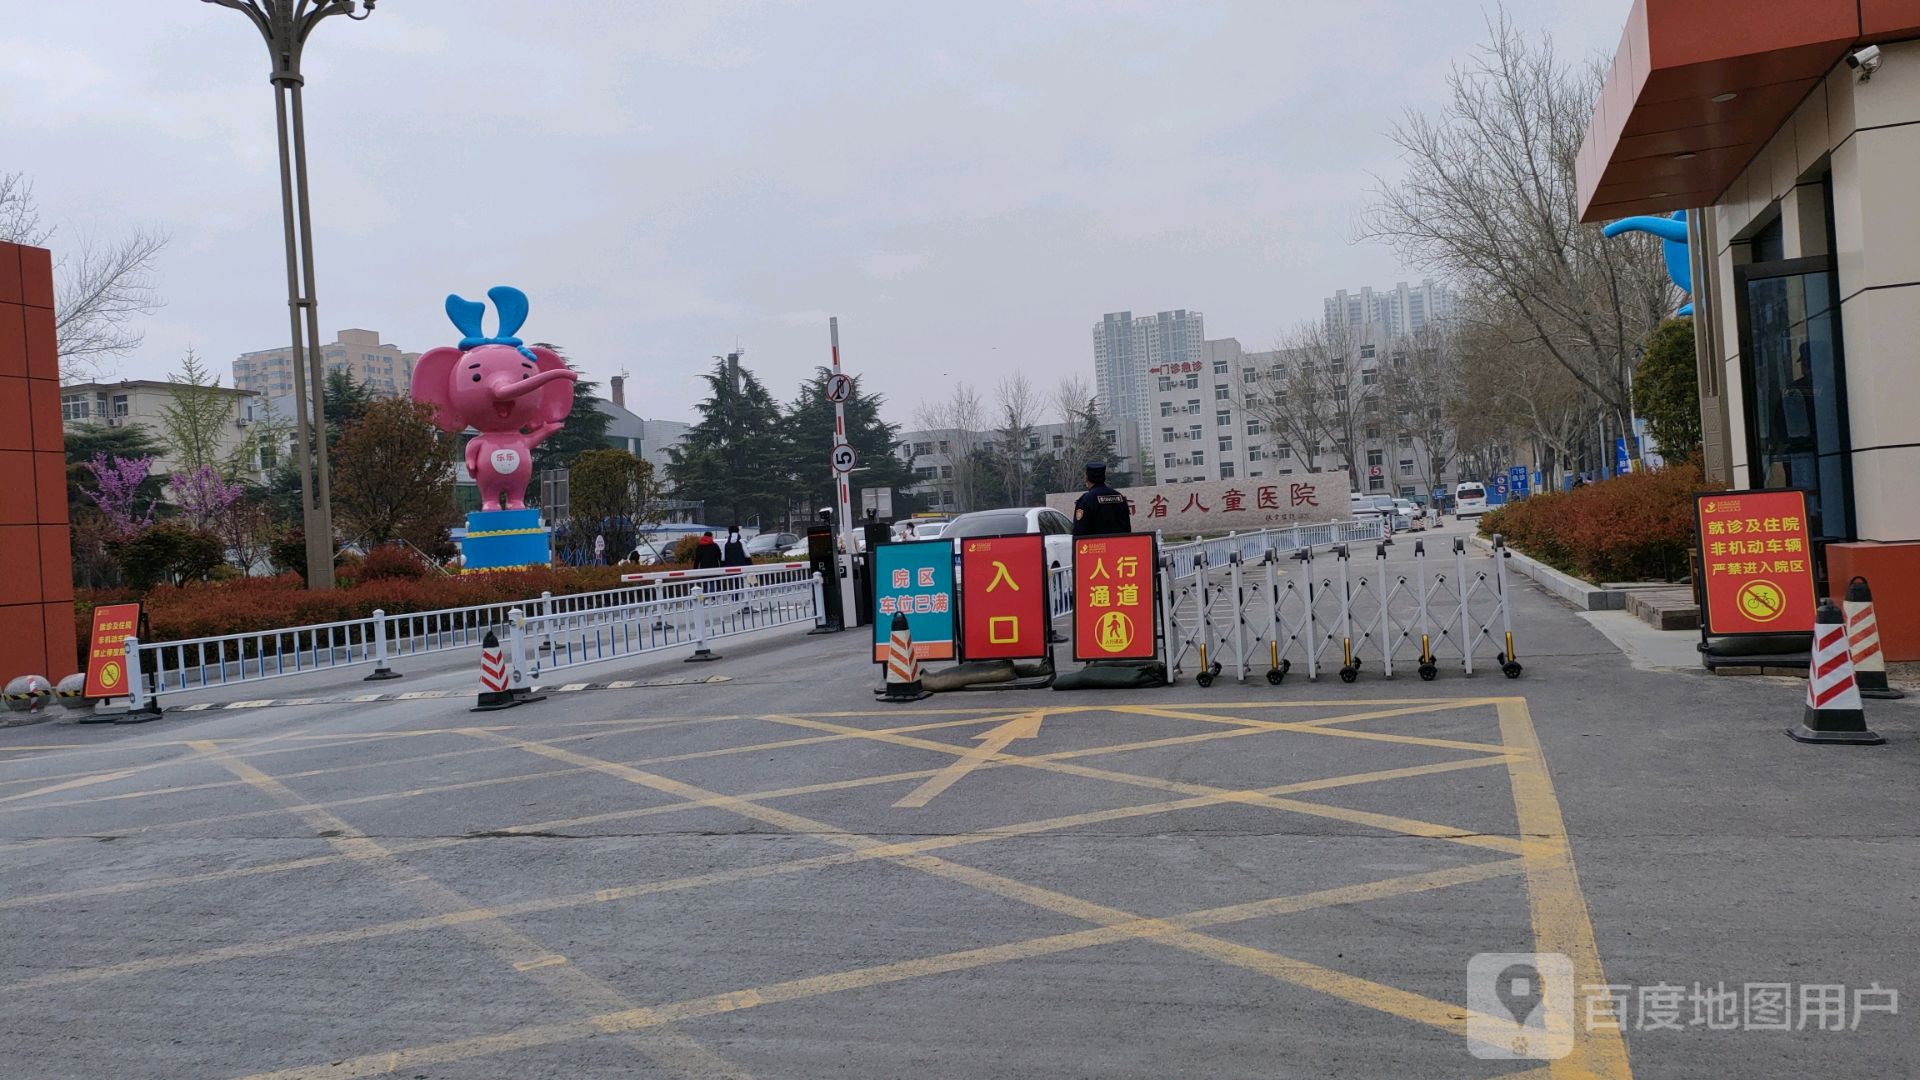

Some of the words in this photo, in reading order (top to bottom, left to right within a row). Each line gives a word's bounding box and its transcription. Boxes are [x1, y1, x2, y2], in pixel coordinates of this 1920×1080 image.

[1160, 360, 1202, 374] 门诊急诊
[836, 451, 852, 465] 5
[1708, 517, 1800, 535] 就诊及住院
[1710, 538, 1802, 556] 非机动车辆
[1089, 556, 1139, 580] 人行
[1712, 560, 1805, 576] 严禁进入院区
[892, 567, 935, 589] 院区
[880, 592, 949, 615] 车位已满
[1089, 583, 1139, 608] 通道
